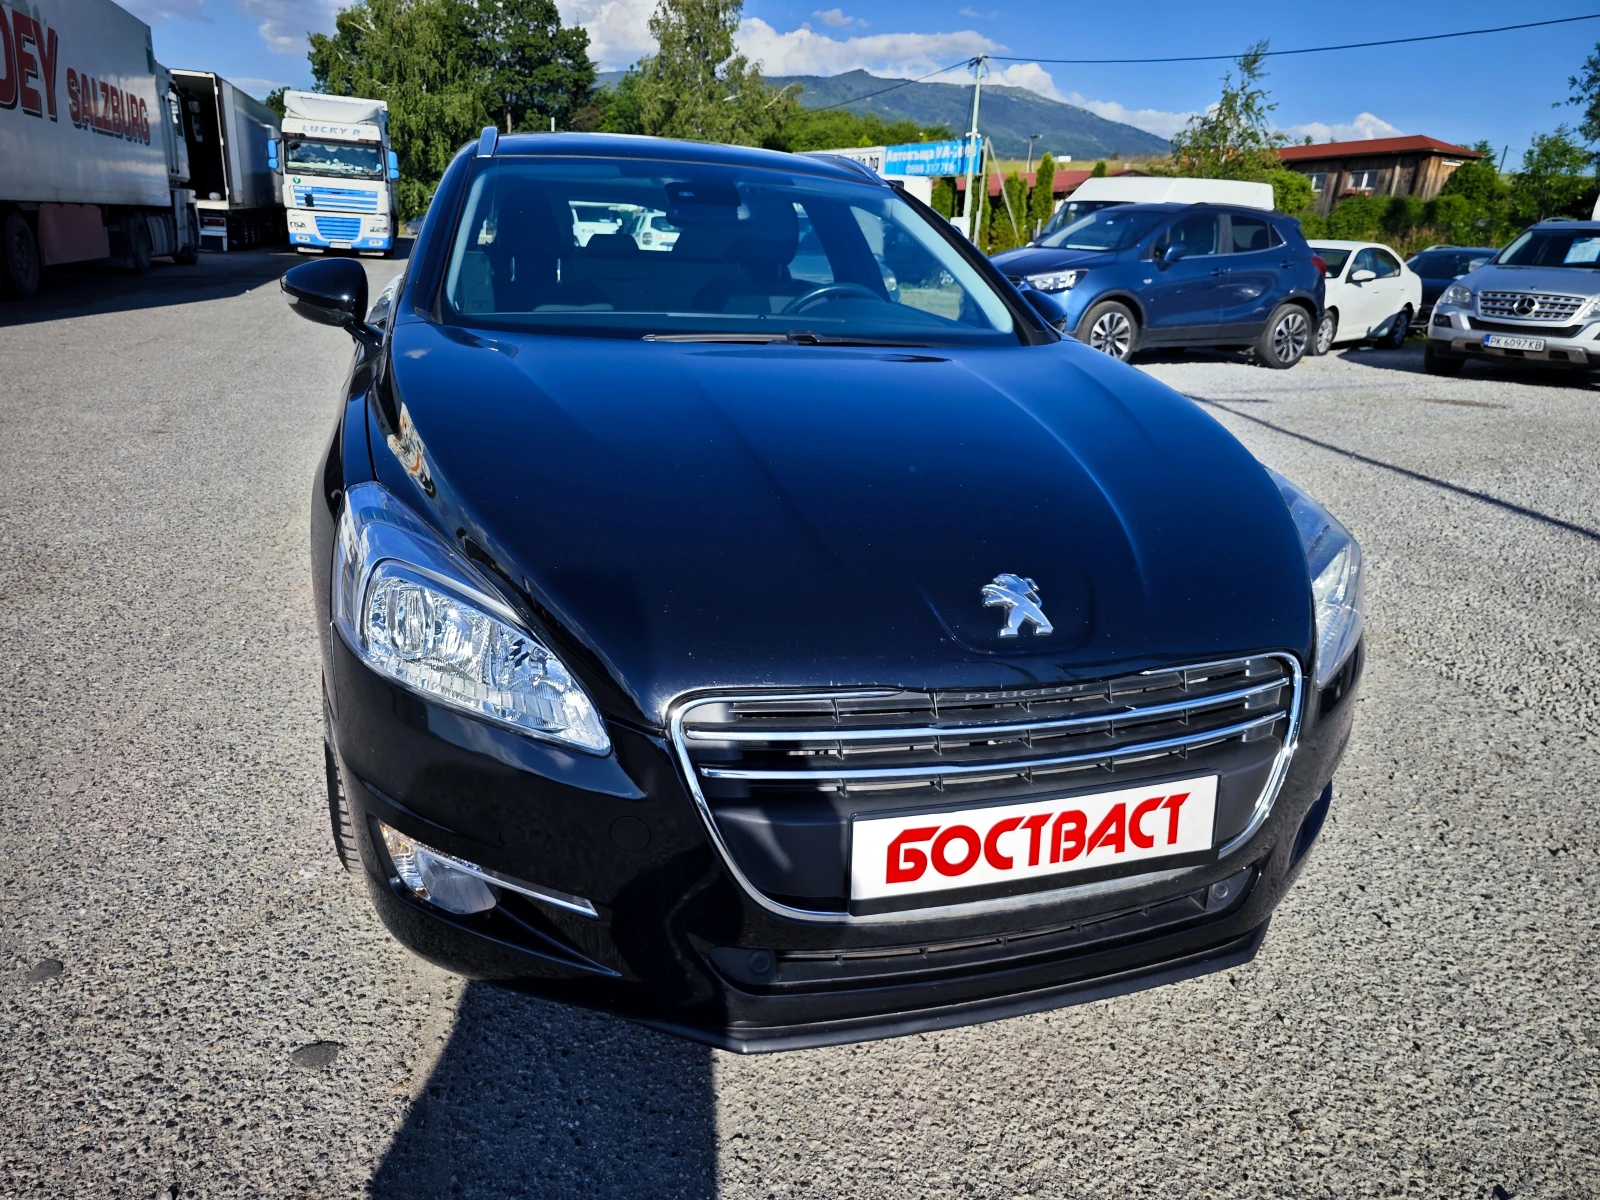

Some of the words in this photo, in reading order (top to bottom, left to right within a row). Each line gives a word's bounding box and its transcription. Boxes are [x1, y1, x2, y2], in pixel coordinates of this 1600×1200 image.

[66, 67, 150, 146] SALZBURG
[302, 124, 347, 135] LUCKY
[1490, 337, 1501, 347] PK
[1503, 338, 1528, 348] 6097
[1528, 340, 1542, 350] KB
[964, 684, 1089, 700] PEUGEOT
[885, 792, 1191, 884] БОСТВАСТ
